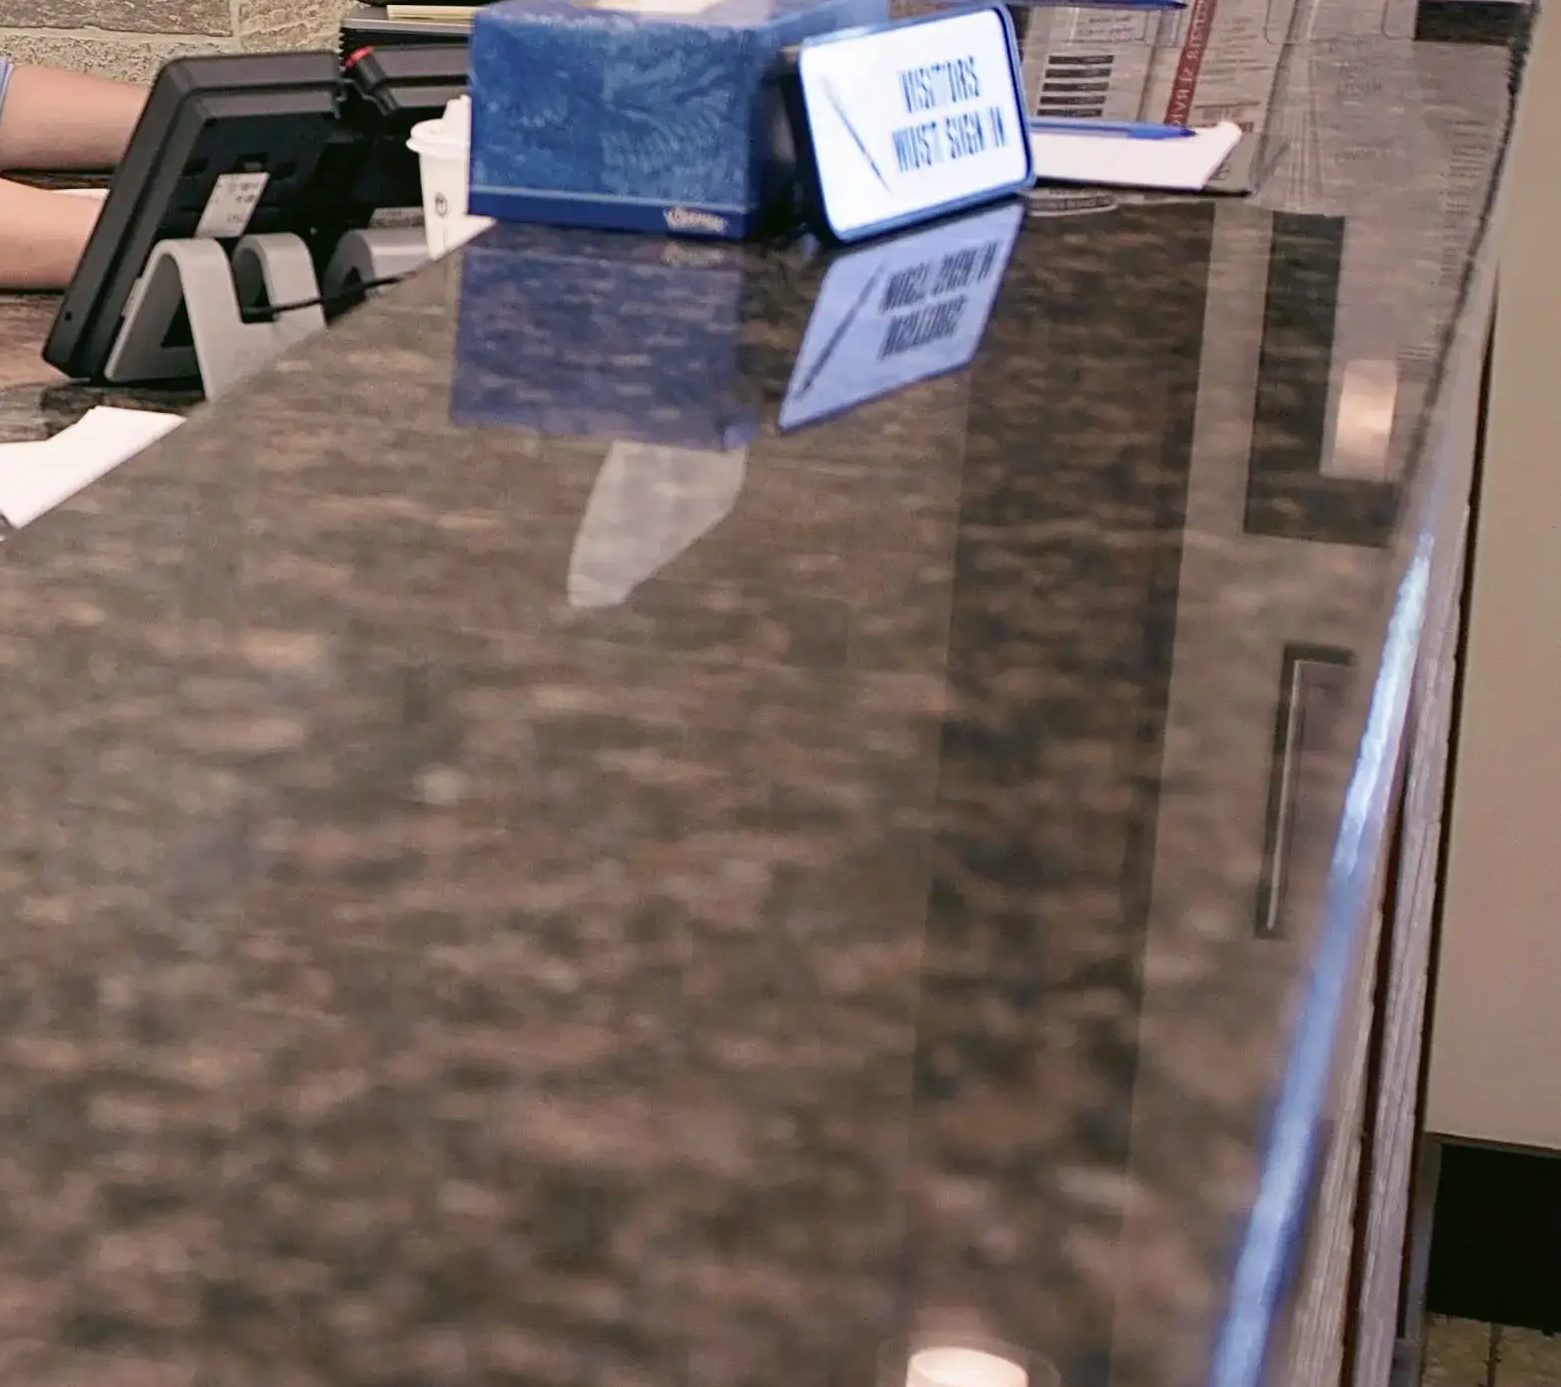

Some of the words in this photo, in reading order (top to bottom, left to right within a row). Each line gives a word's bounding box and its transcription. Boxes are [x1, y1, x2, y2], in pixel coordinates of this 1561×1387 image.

[892, 120, 943, 174] MUST
[946, 111, 985, 160] SIGN
[989, 106, 1006, 147] IN
